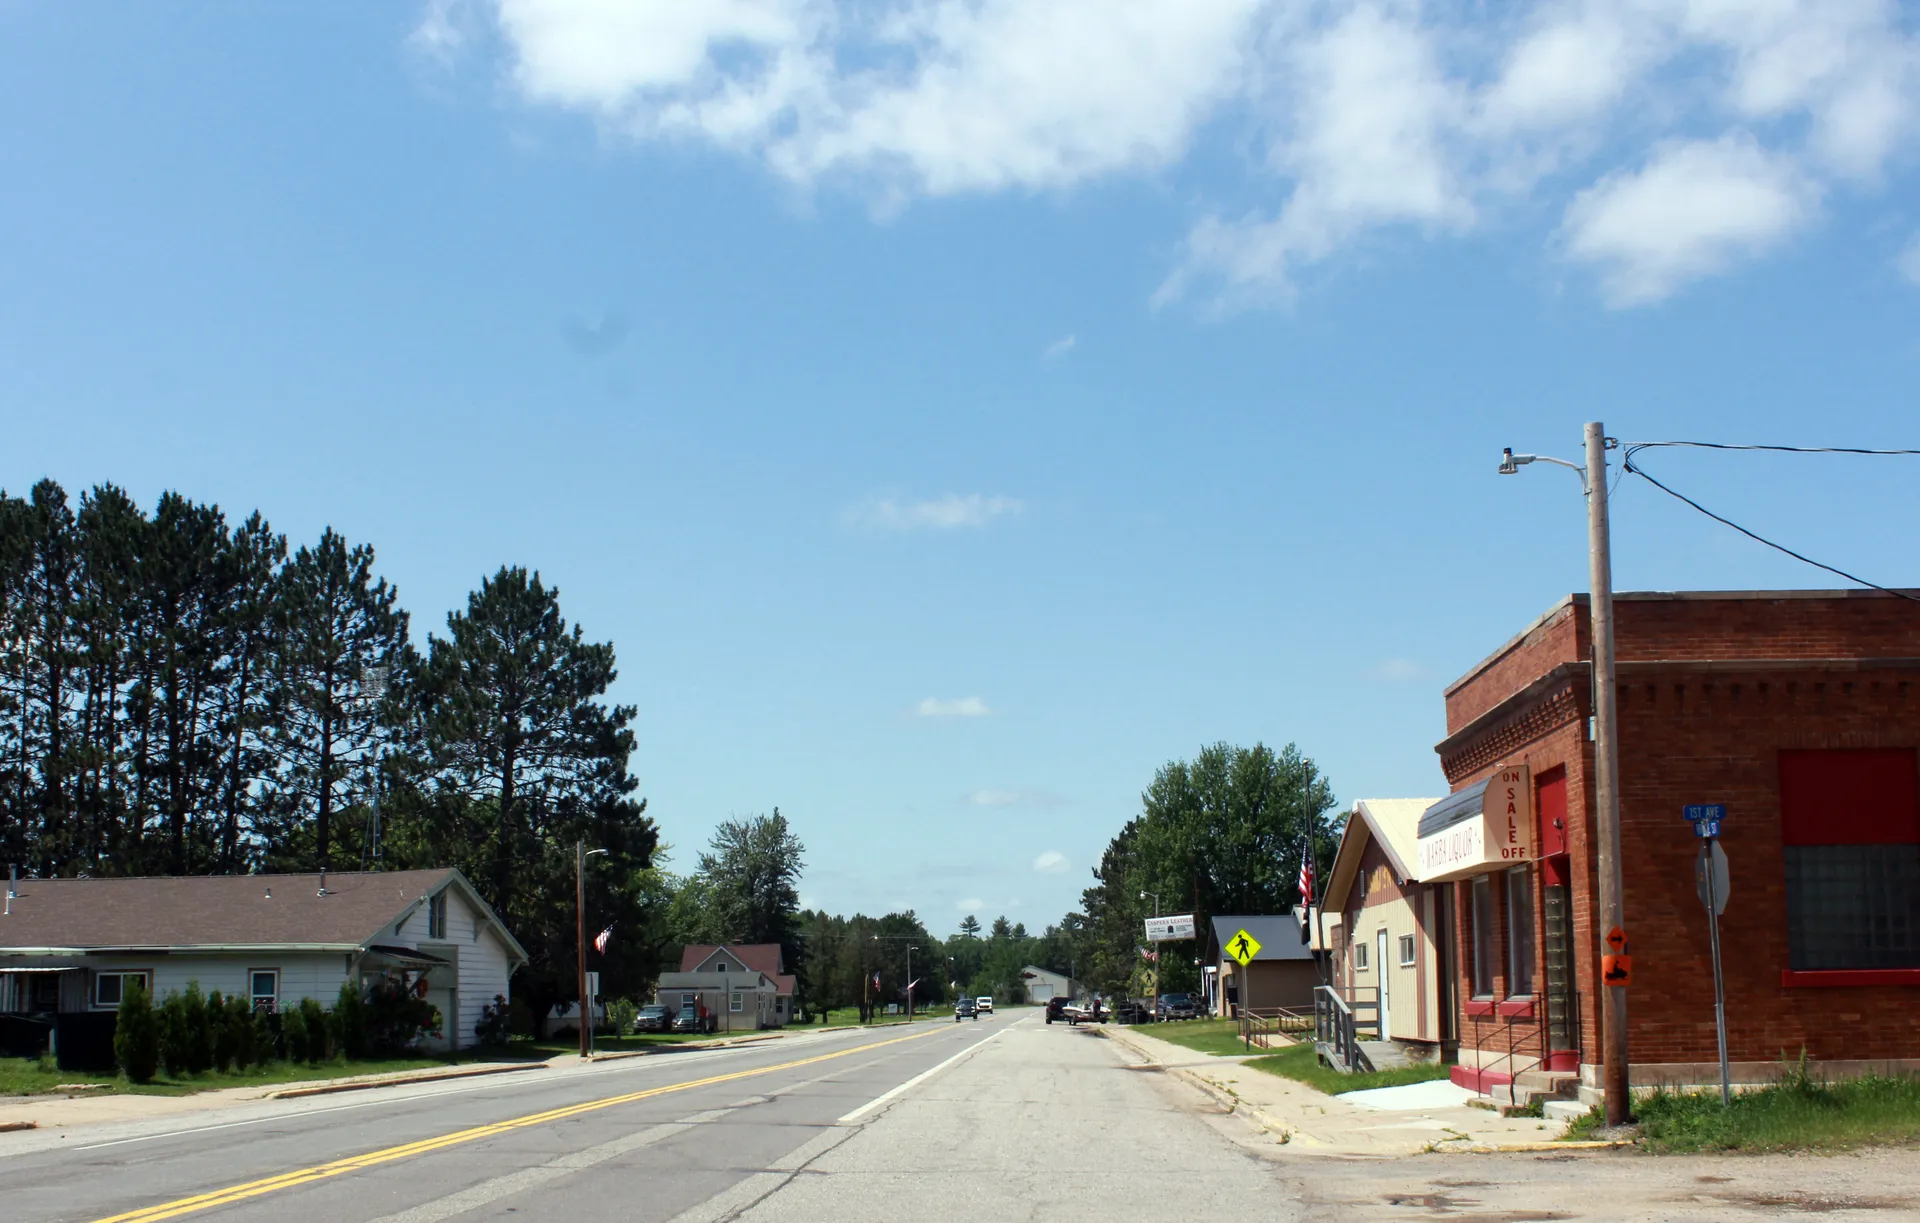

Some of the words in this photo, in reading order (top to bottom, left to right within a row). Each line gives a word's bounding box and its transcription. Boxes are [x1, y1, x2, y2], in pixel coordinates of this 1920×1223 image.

[1502, 772, 1520, 782] ON
[1507, 788, 1517, 844] SALE
[1689, 807, 1701, 819] 1ST
[1705, 806, 1720, 818] AVE
[1426, 837, 1447, 869] WARBA
[1448, 826, 1473, 864] LIQUOR
[1501, 847, 1525, 859] OFF
[1170, 917, 1193, 925] LEATHER
